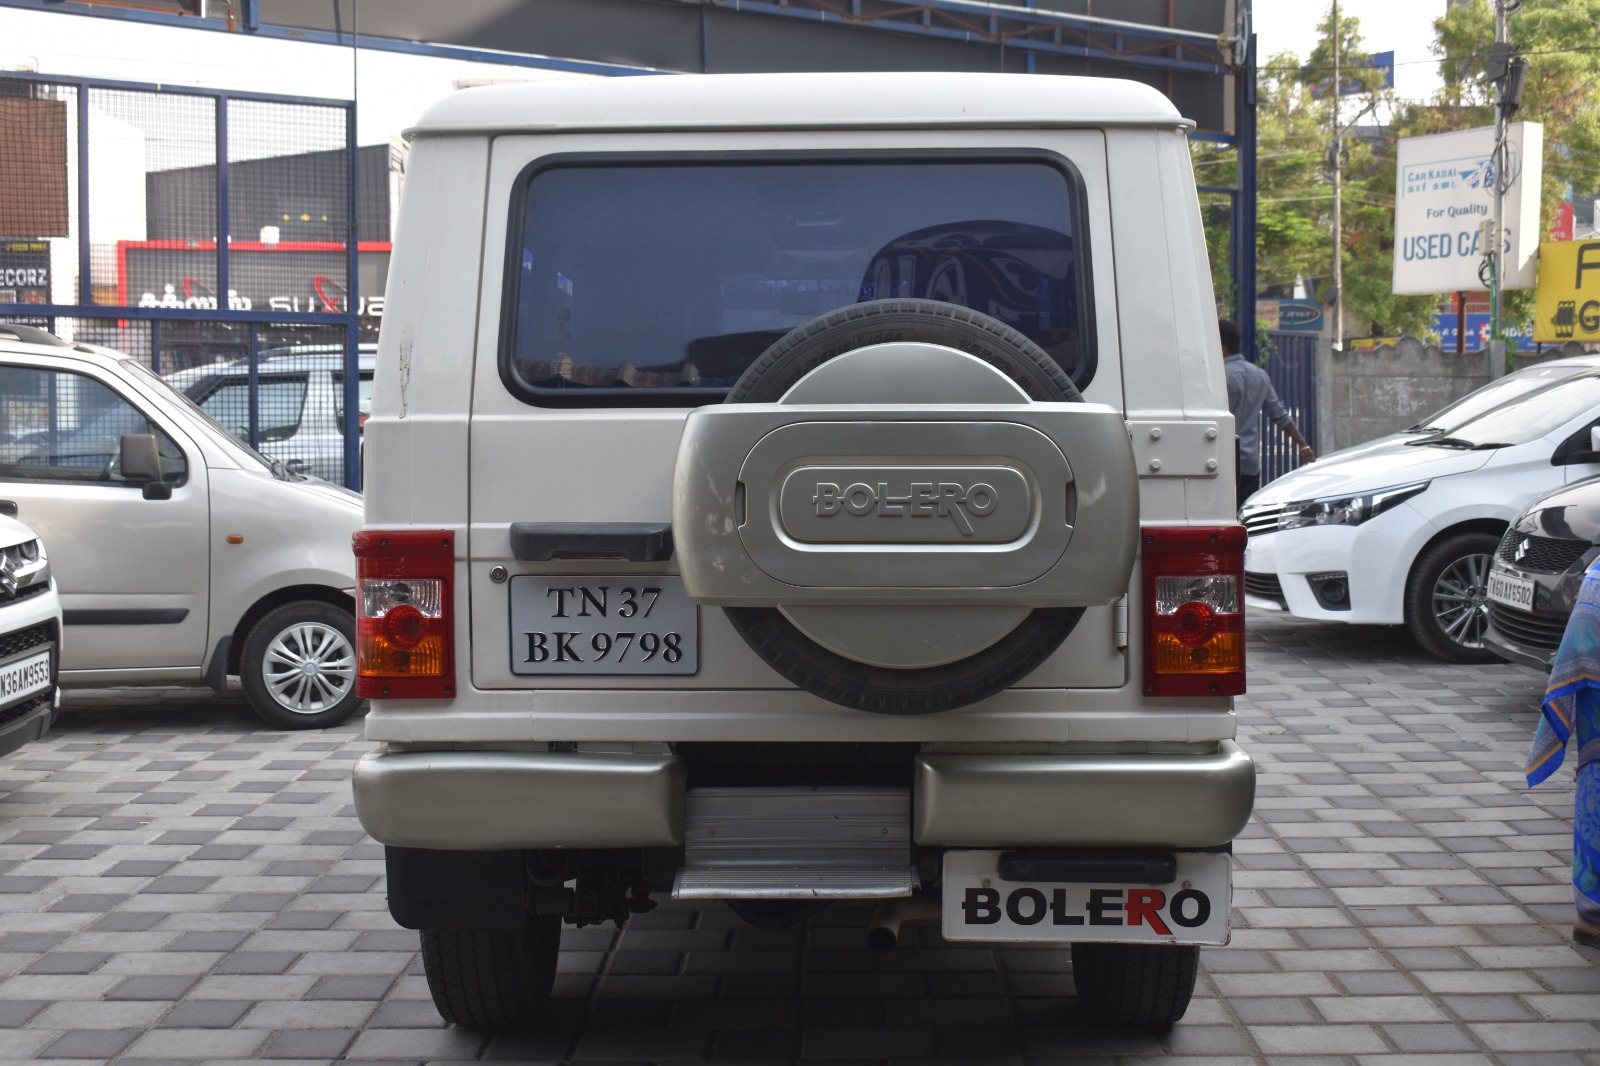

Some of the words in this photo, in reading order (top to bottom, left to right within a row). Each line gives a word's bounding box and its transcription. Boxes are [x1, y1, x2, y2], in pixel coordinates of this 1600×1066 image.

[1426, 208, 1445, 219] For
[1447, 203, 1488, 218] Quality
[1403, 233, 1452, 261] USED
[1457, 228, 1512, 257] CAS
[813, 483, 998, 536] BOLERO
[546, 586, 609, 618] TN
[617, 587, 663, 618] 37
[1489, 577, 1532, 606] TN60AX6502
[523, 631, 584, 663] BK
[590, 631, 683, 663] 9798
[962, 887, 1211, 935] BOLERO
